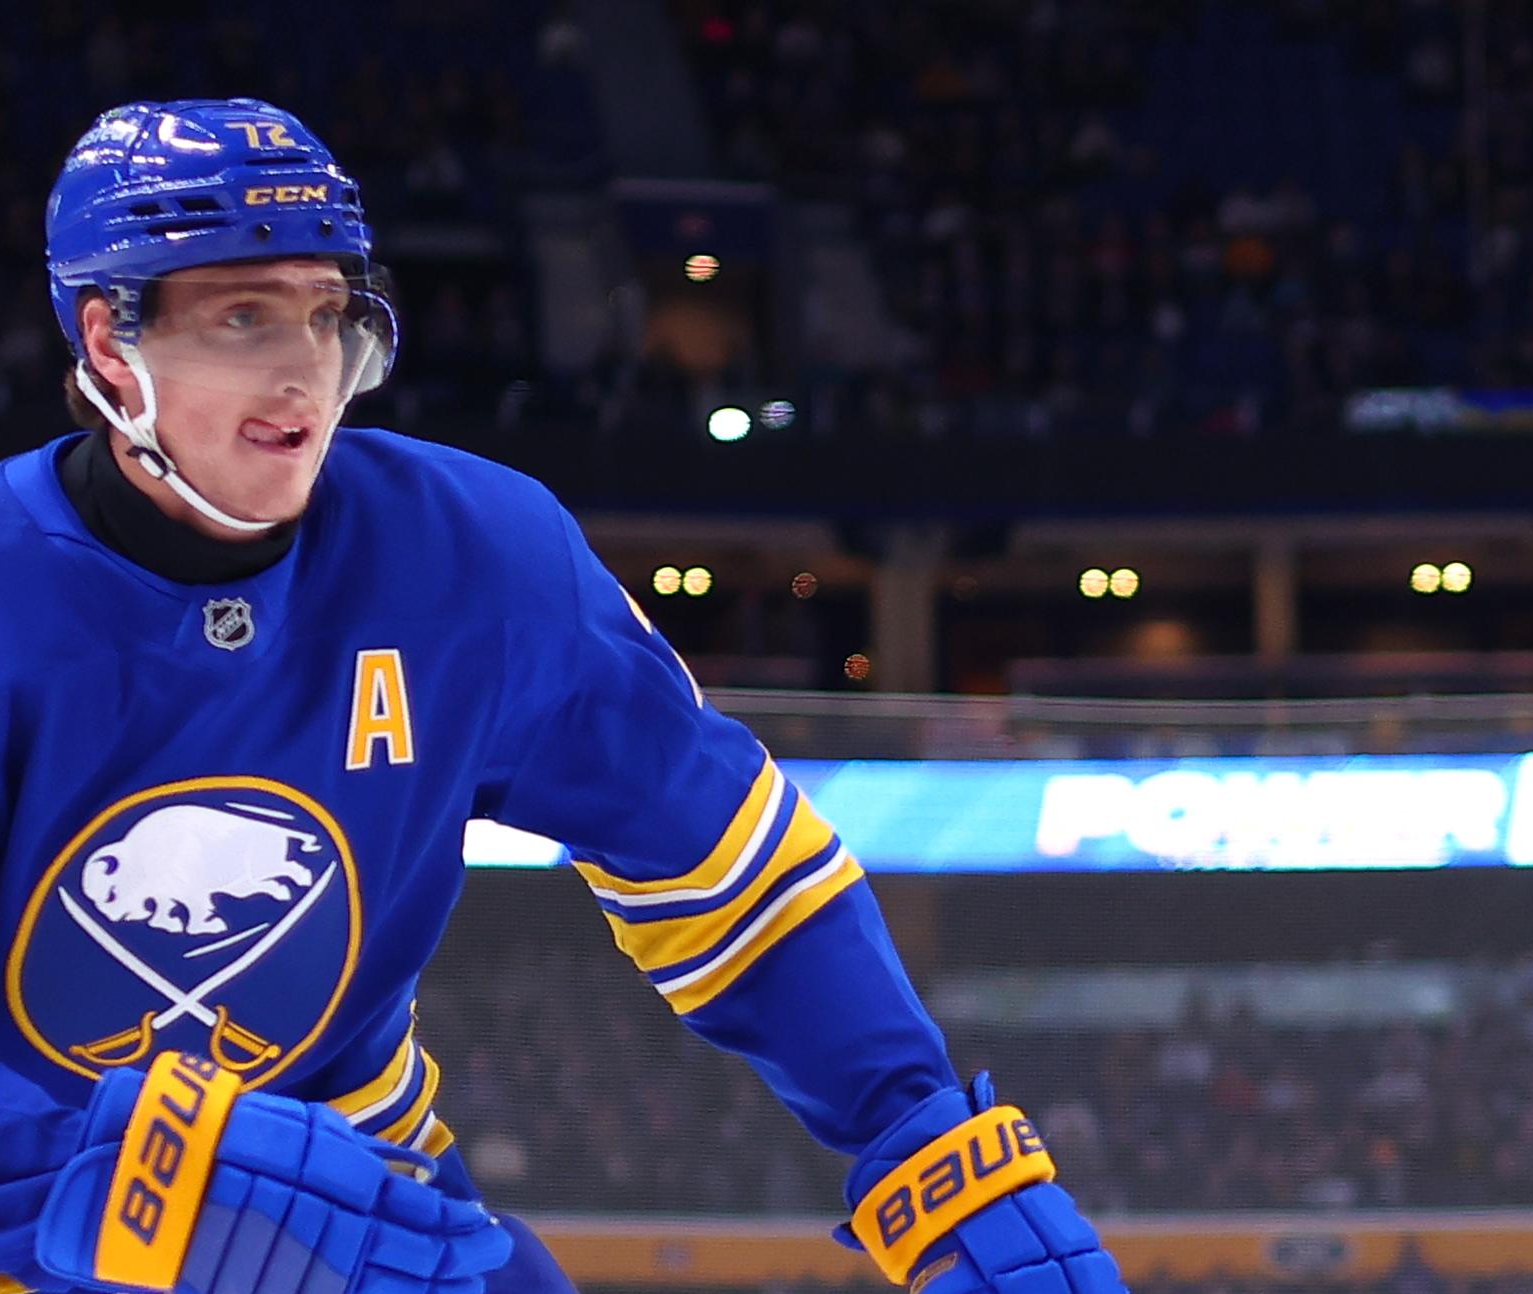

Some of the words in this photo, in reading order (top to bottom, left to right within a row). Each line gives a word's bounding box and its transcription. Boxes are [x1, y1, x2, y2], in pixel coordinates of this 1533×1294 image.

[224, 121, 295, 148] 72
[244, 184, 329, 205] CCM
[346, 648, 414, 771] A
[1035, 768, 1506, 857] POWER
